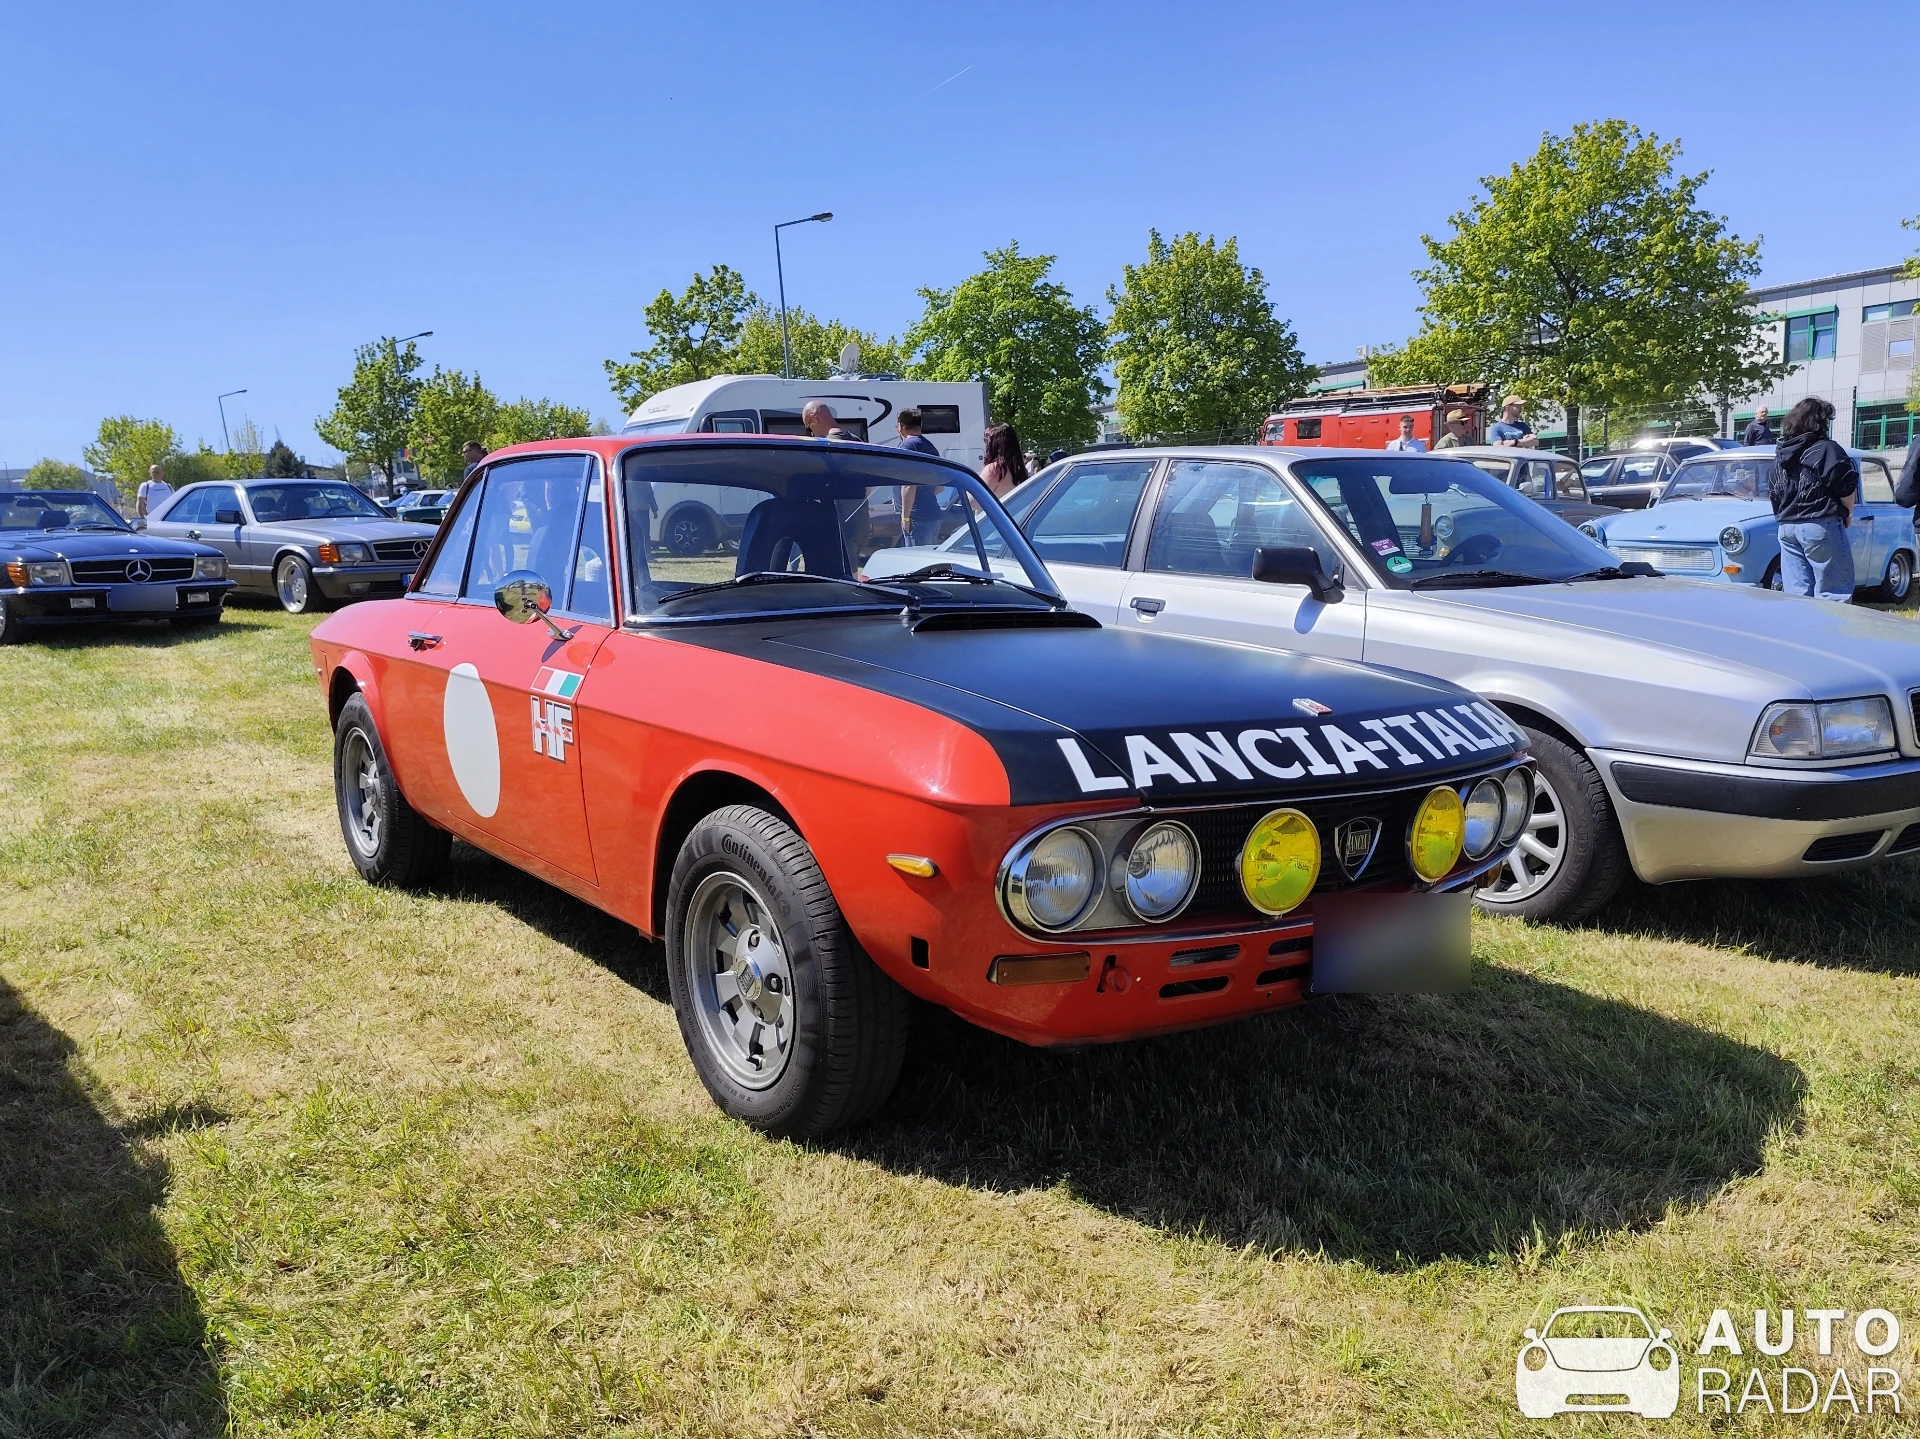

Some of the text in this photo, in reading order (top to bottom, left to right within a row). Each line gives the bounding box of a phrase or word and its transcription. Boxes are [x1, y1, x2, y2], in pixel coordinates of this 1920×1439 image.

[530, 695, 574, 764] HF
[1057, 701, 1526, 792] LANCIA-ITALIA
[721, 833, 784, 901] Continental
